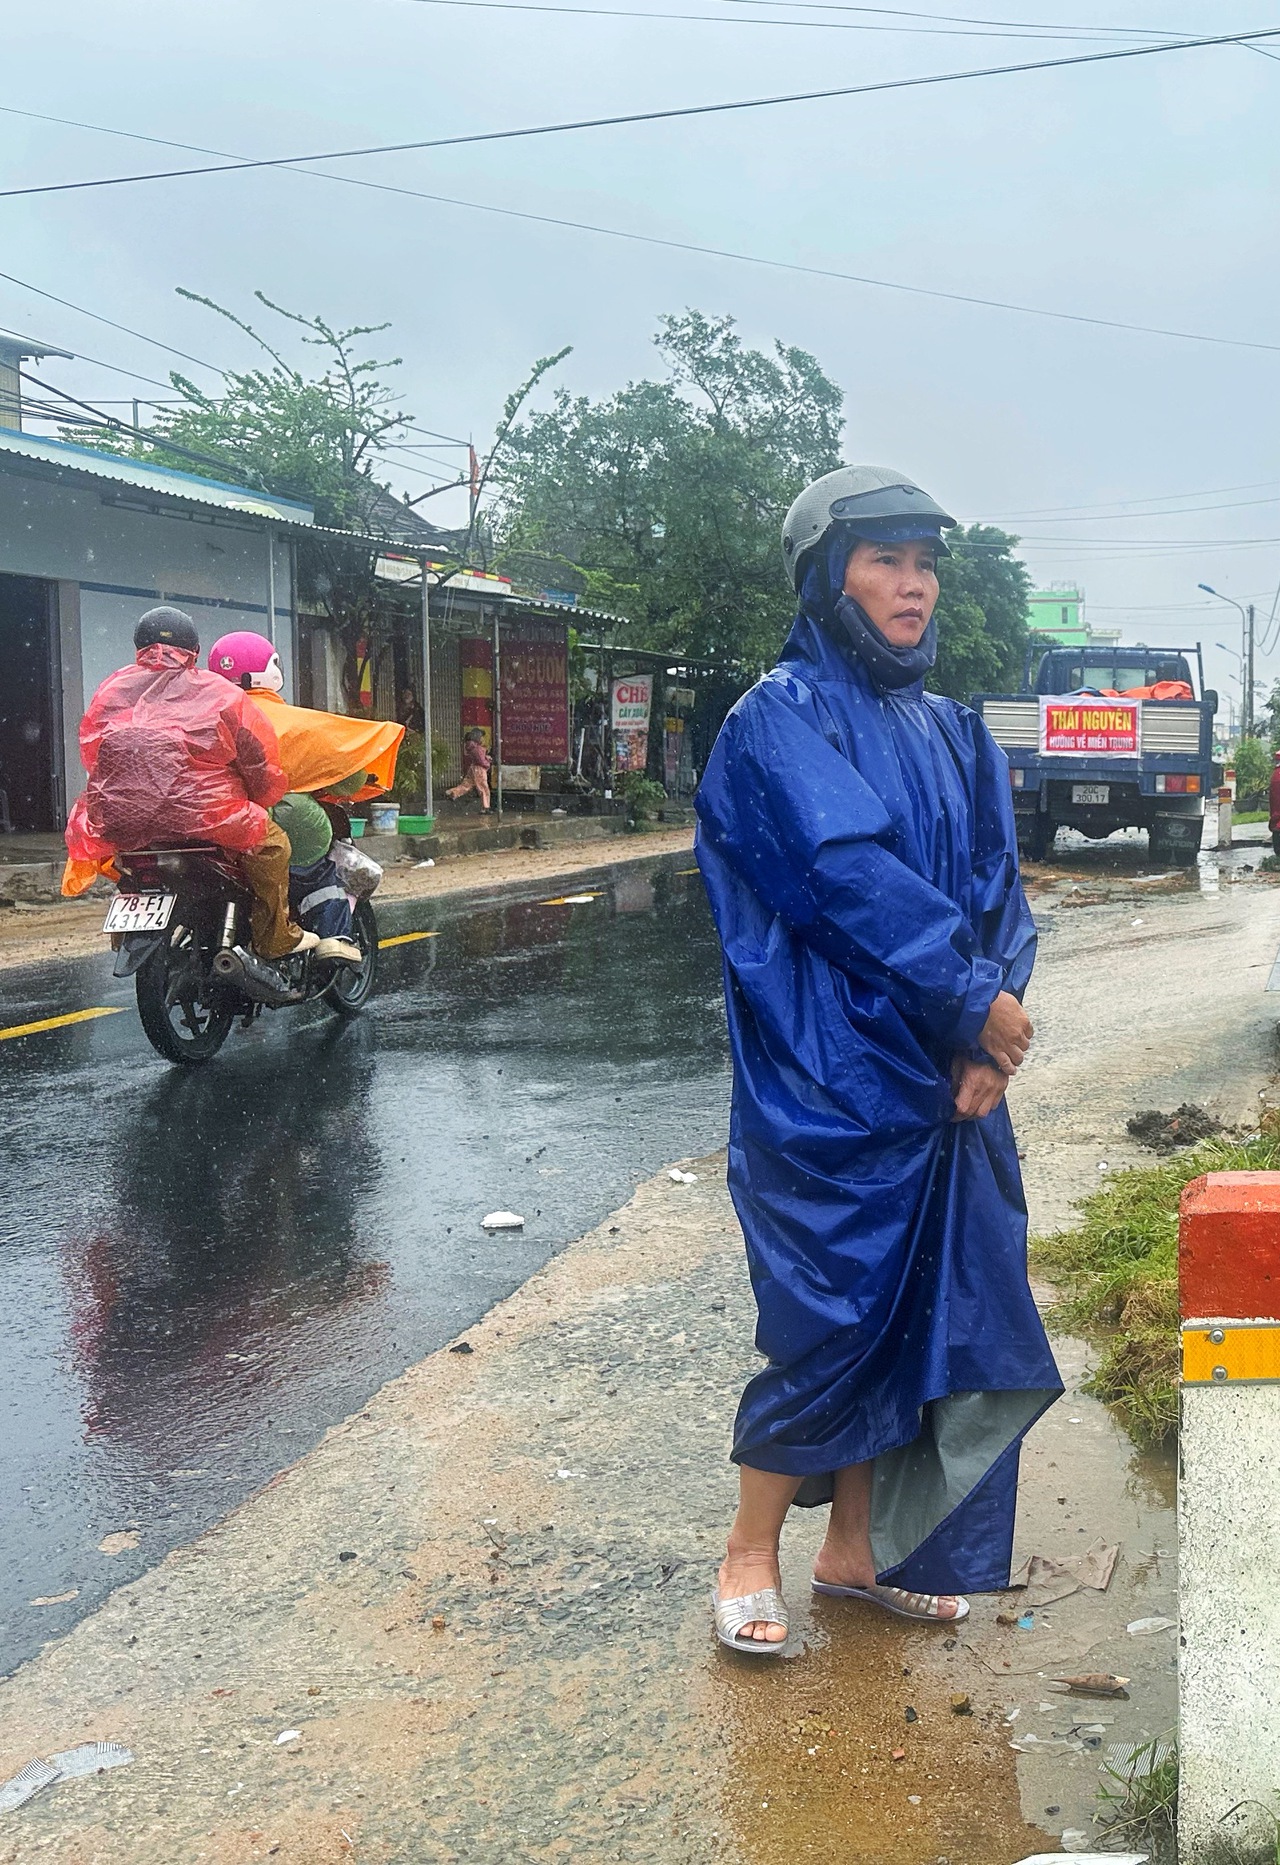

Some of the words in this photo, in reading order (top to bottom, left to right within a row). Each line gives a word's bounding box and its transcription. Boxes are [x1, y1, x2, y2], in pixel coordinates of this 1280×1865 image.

[1051, 707, 1080, 730] THÁI
[1082, 708, 1132, 731] NGUYÊN
[1108, 737, 1134, 749] TRUNG
[120, 896, 165, 912] 78-F1
[109, 912, 164, 930] 431.74
